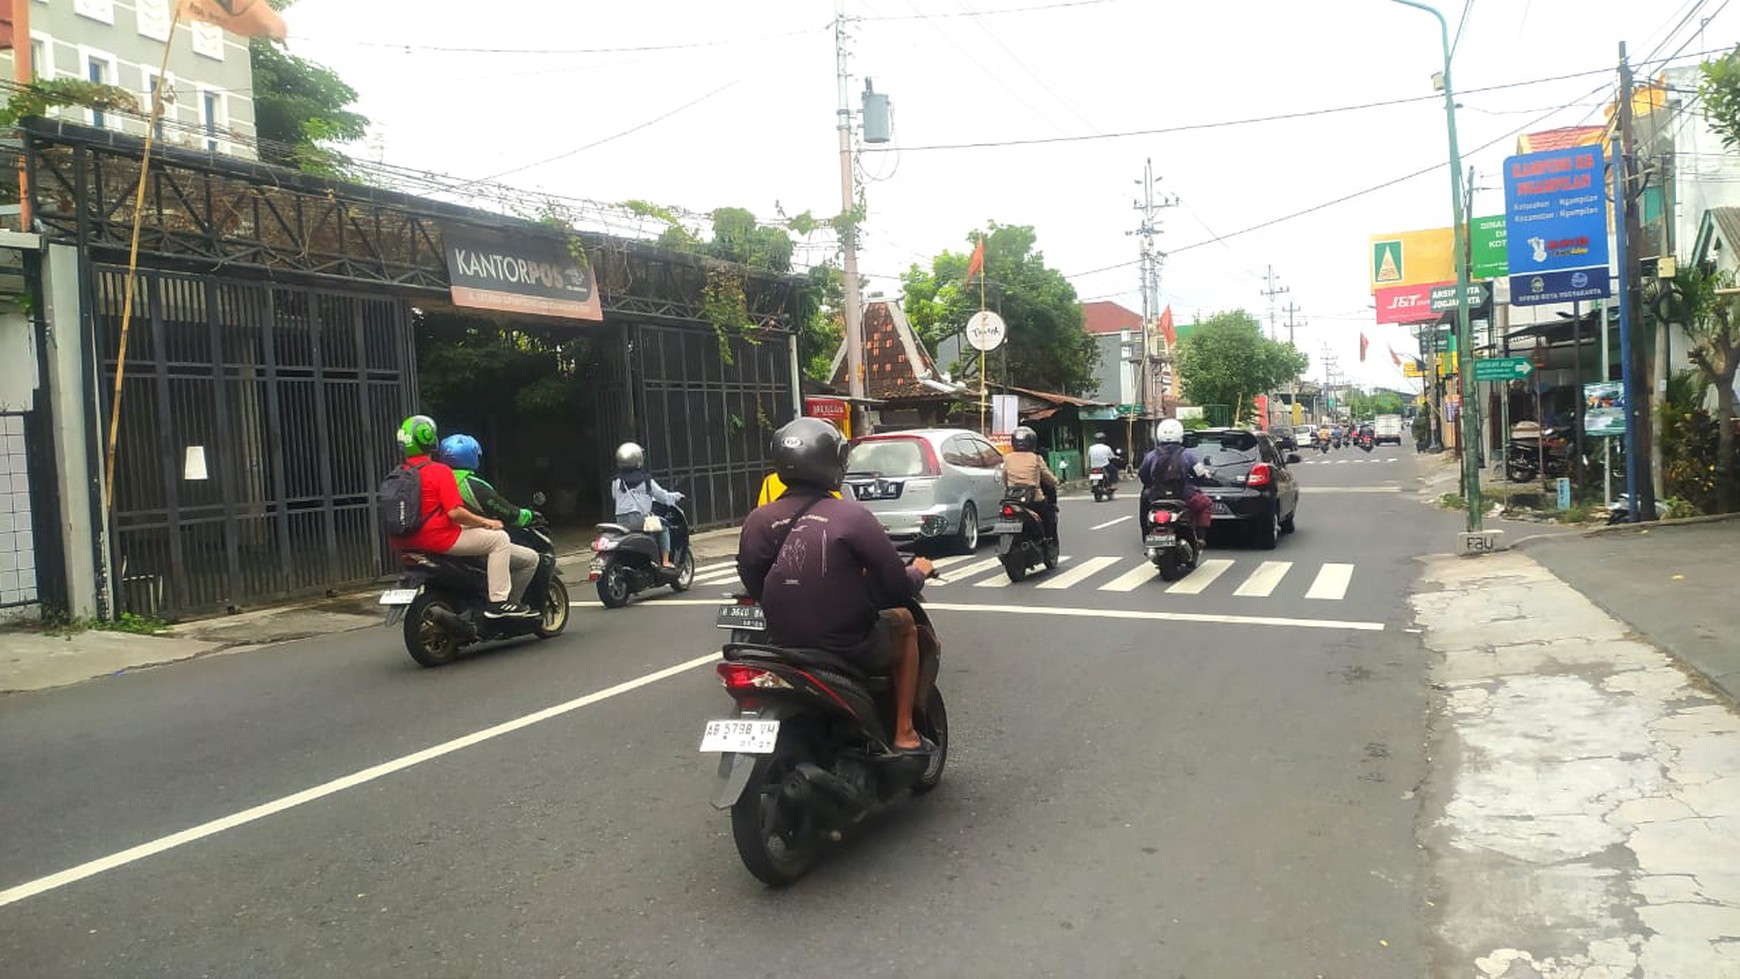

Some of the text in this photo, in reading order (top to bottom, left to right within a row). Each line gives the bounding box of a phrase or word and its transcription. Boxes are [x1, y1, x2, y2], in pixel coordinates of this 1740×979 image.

[1488, 238, 1508, 249] KOT
[1386, 293, 1422, 310] J&T
[706, 723, 721, 736] AB
[723, 722, 753, 735] 5798
